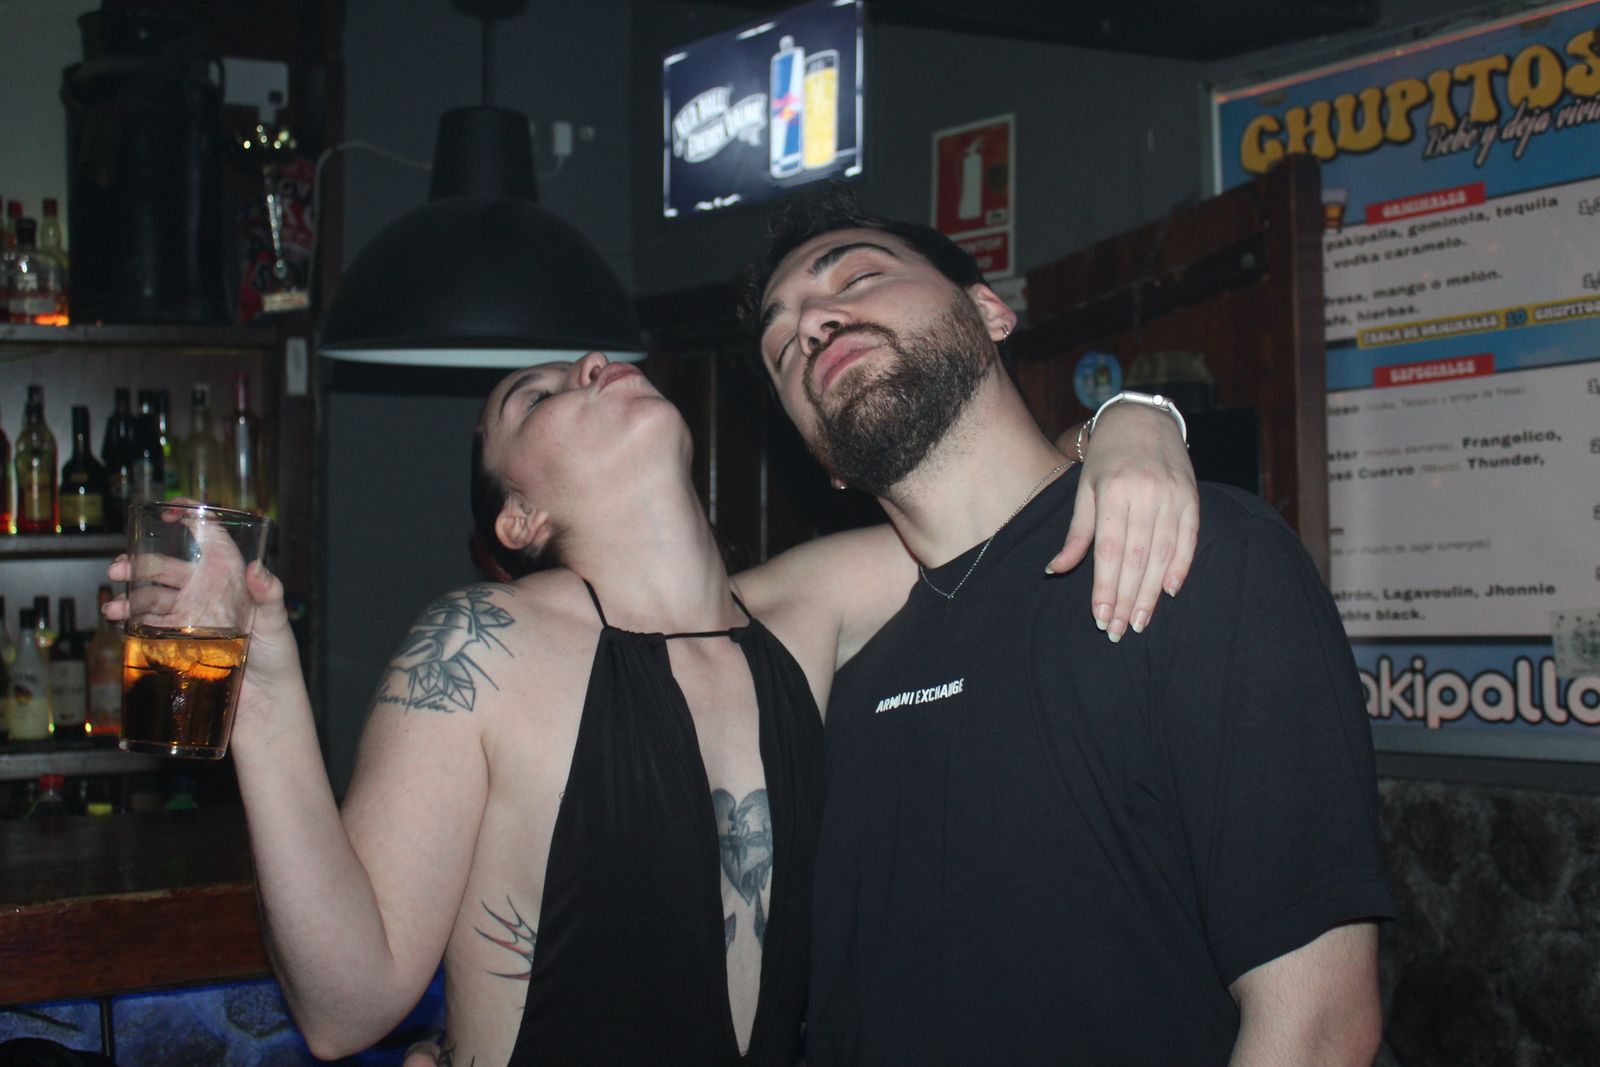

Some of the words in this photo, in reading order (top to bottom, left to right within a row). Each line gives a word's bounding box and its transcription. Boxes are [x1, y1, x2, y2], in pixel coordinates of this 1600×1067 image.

[1240, 29, 1600, 174] CHUPITOS
[1423, 114, 1478, 160] Bebe
[1474, 123, 1498, 167] y
[1501, 97, 1552, 159] deja
[1556, 93, 1600, 129] vivi
[1407, 210, 1490, 239] gominola,
[1496, 196, 1558, 220] tequila
[1384, 237, 1466, 260] caramelo.
[1373, 277, 1426, 299] mango
[1431, 279, 1441, 290] o
[1446, 268, 1502, 288] melón.
[1462, 429, 1561, 450] Frangelico,
[1358, 463, 1415, 480] Cuervo
[1466, 452, 1545, 470] Thunder,
[1333, 589, 1378, 603] atrón,
[1383, 585, 1479, 602] Lagavoulin,
[1485, 583, 1556, 597] Jhonnie
[1376, 609, 1426, 621] black.
[875, 691, 914, 713] ARMANI
[915, 678, 964, 704] EXCHANGE
